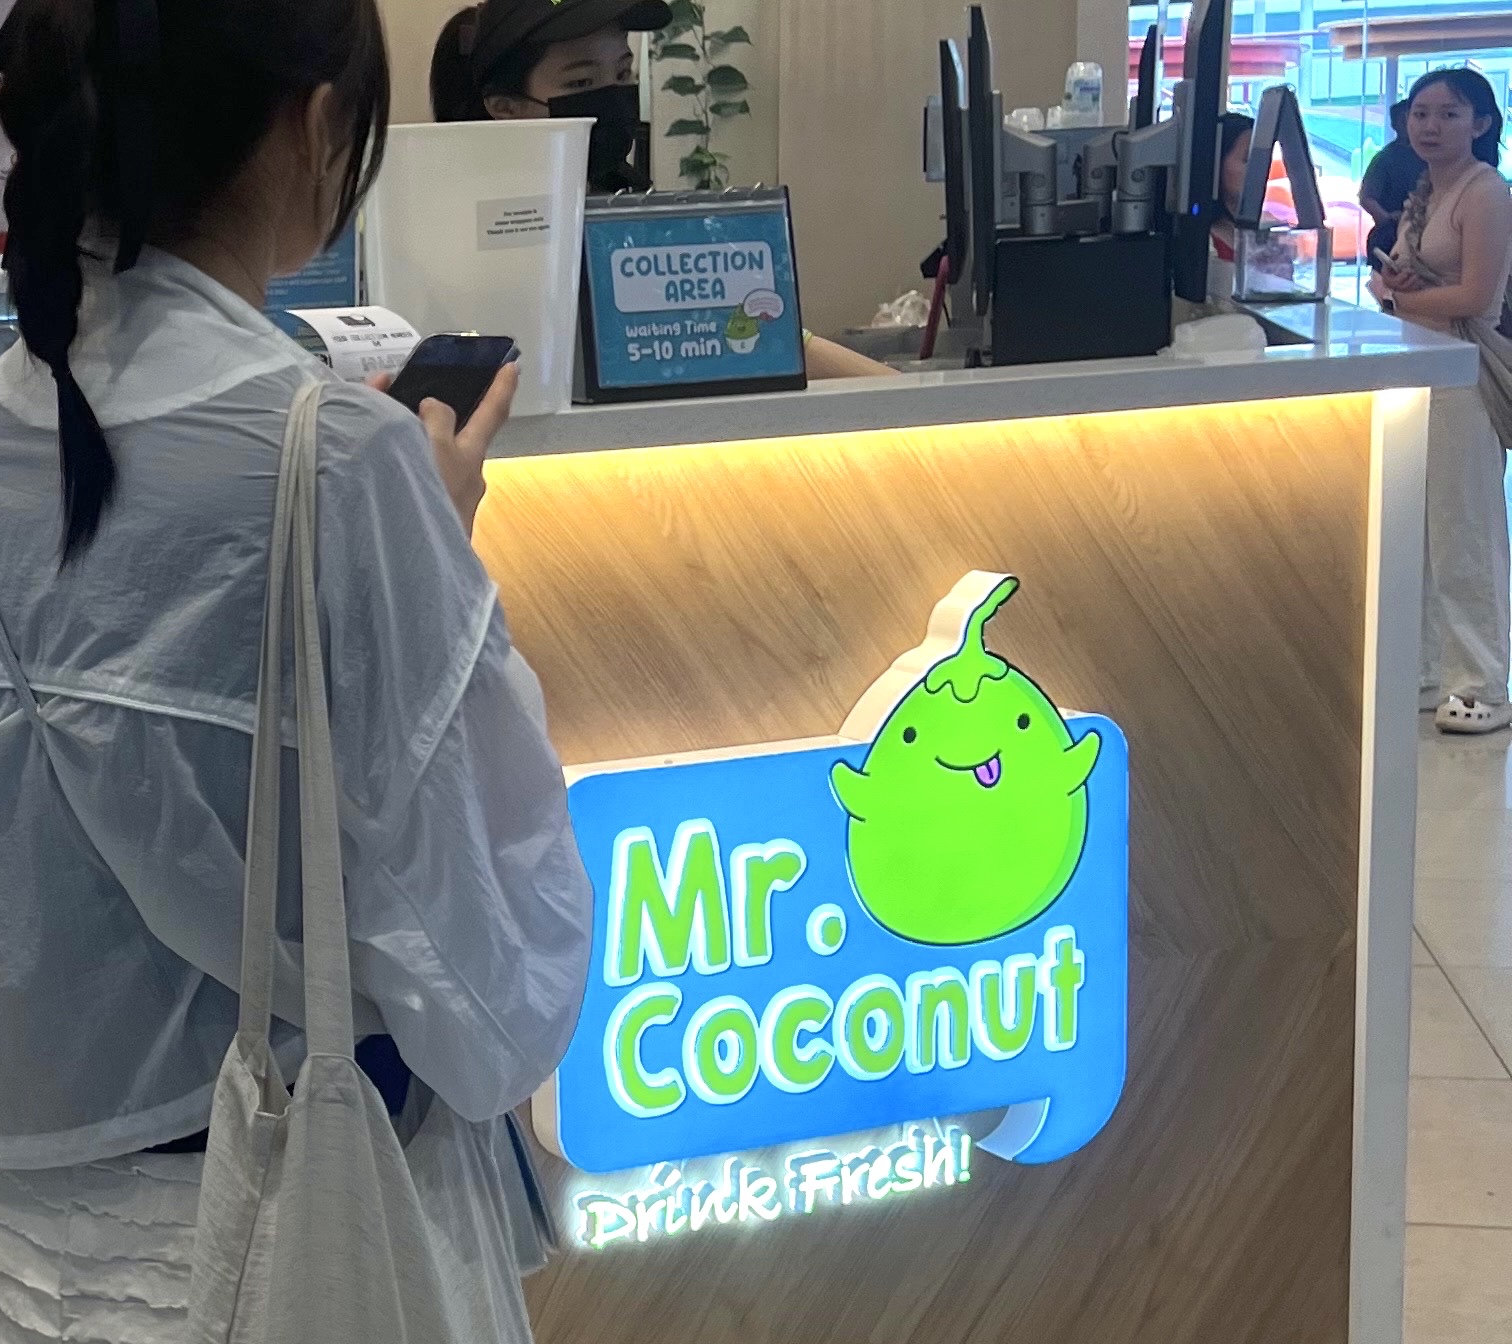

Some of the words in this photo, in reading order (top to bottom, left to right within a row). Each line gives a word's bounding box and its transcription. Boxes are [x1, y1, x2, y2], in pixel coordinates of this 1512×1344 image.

[619, 249, 765, 278] COLLECTION
[664, 277, 726, 303] AREA
[684, 319, 717, 335] Time
[627, 340, 674, 362] 5-10
[680, 338, 722, 358] min
[605, 818, 848, 988] Mr.
[603, 925, 1086, 1119] Coconut
[580, 1159, 783, 1250] Drink
[790, 1130, 973, 1214] Fresh!
